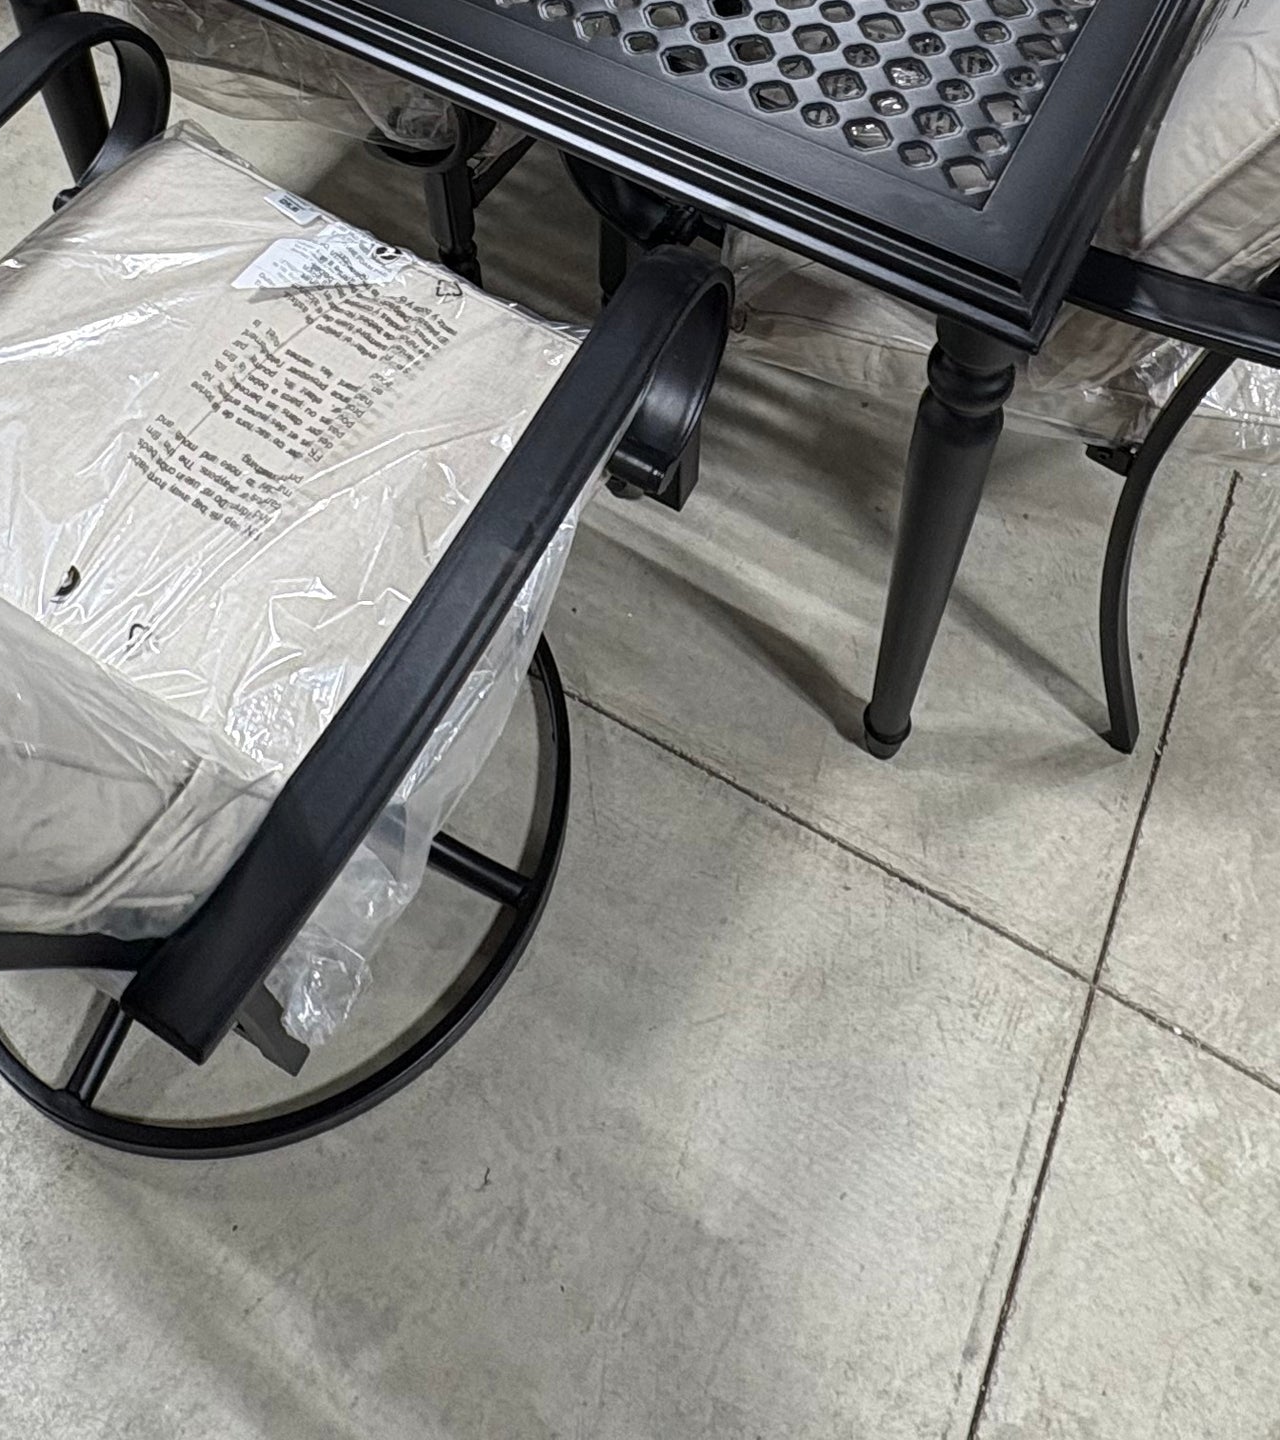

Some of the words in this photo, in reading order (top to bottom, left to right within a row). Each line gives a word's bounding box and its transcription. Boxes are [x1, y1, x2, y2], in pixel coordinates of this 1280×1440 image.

[231, 336, 248, 351] par
[155, 413, 175, 429] and
[220, 407, 235, 421] de
[176, 454, 195, 470] The
[212, 494, 228, 508] Do
